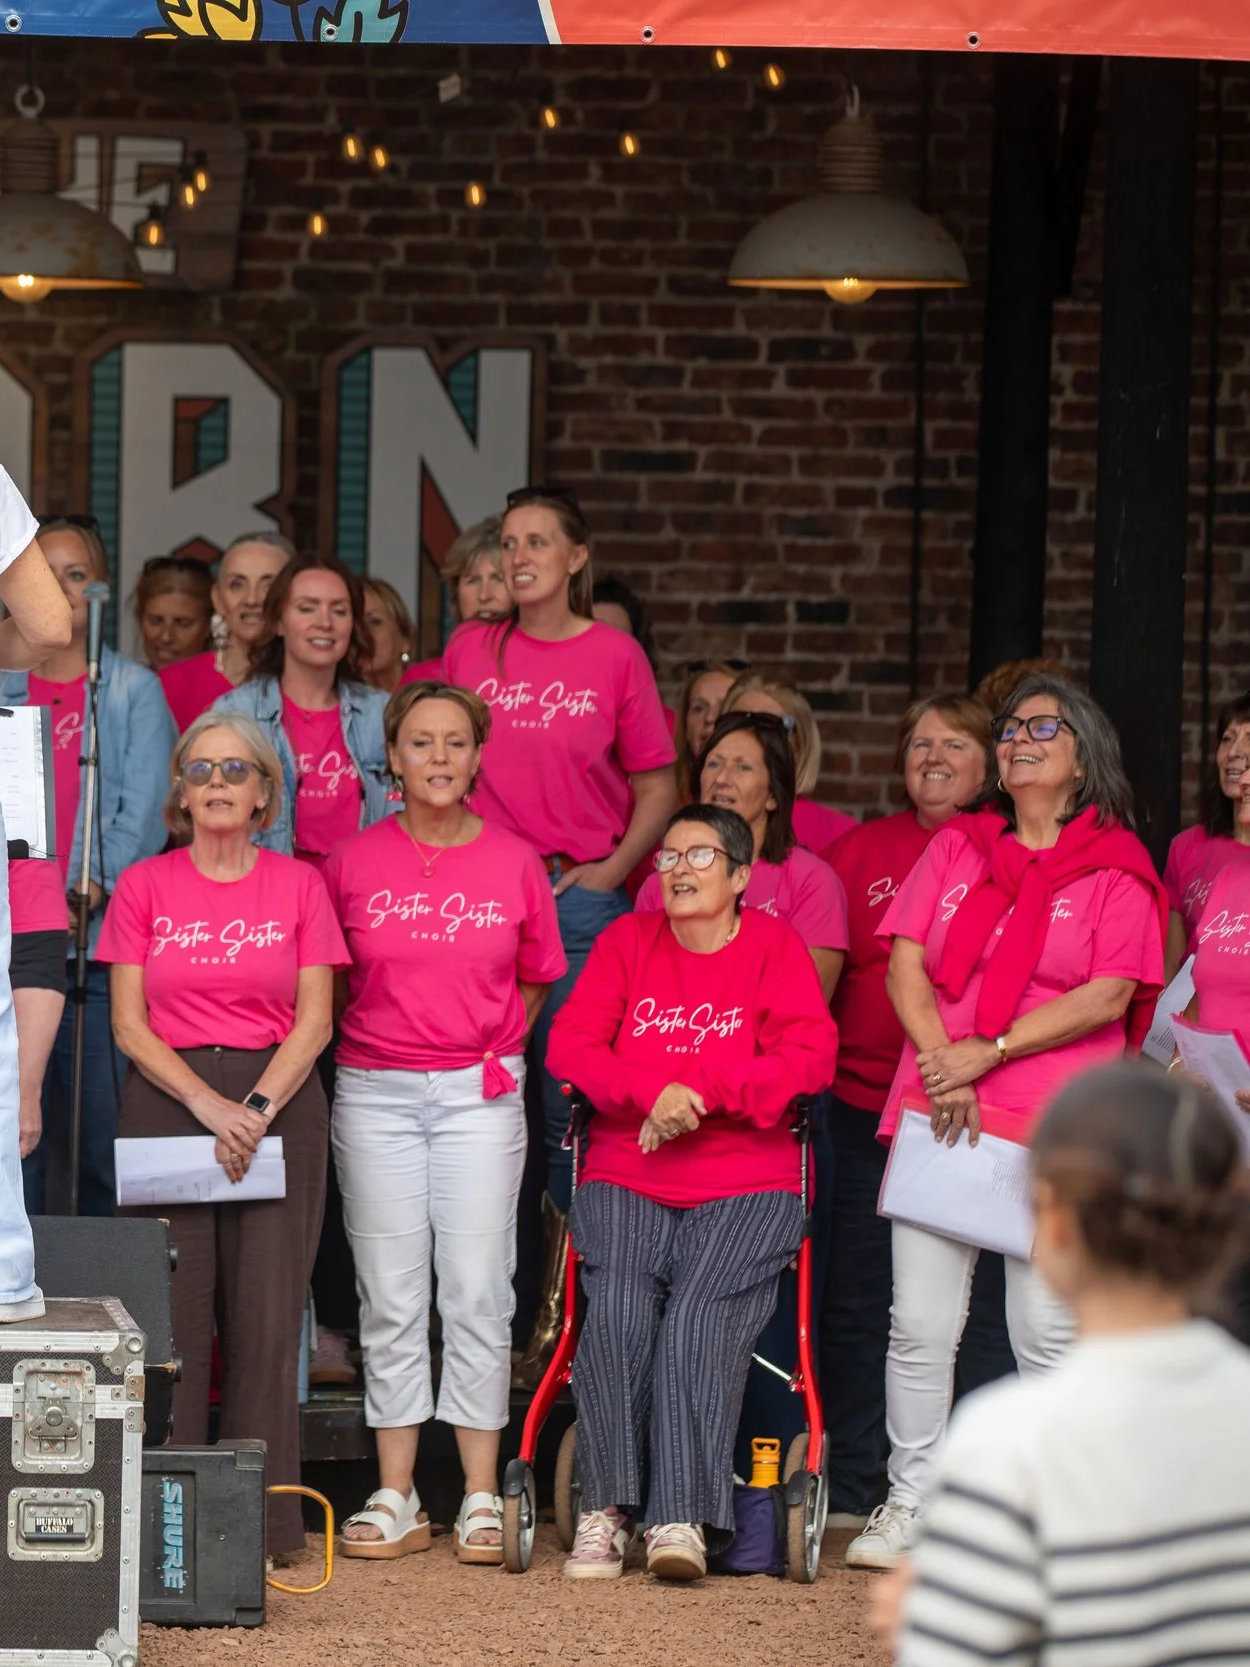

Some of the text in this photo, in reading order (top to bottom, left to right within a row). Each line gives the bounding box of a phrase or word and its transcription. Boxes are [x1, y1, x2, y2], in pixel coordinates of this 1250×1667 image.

[476, 677, 598, 721] Sister Sister
[366, 889, 508, 934] Sister Sister
[152, 916, 286, 957] Sister Sister
[411, 930, 456, 943] CHOIR
[190, 956, 237, 965] CHOIR
[632, 997, 744, 1046] Sister Sister
[666, 1044, 700, 1055] CHOIR
[36, 1517, 74, 1526] BUFFALO
[40, 1525, 67, 1533] CASES
[162, 1481, 184, 1589] SHURE
